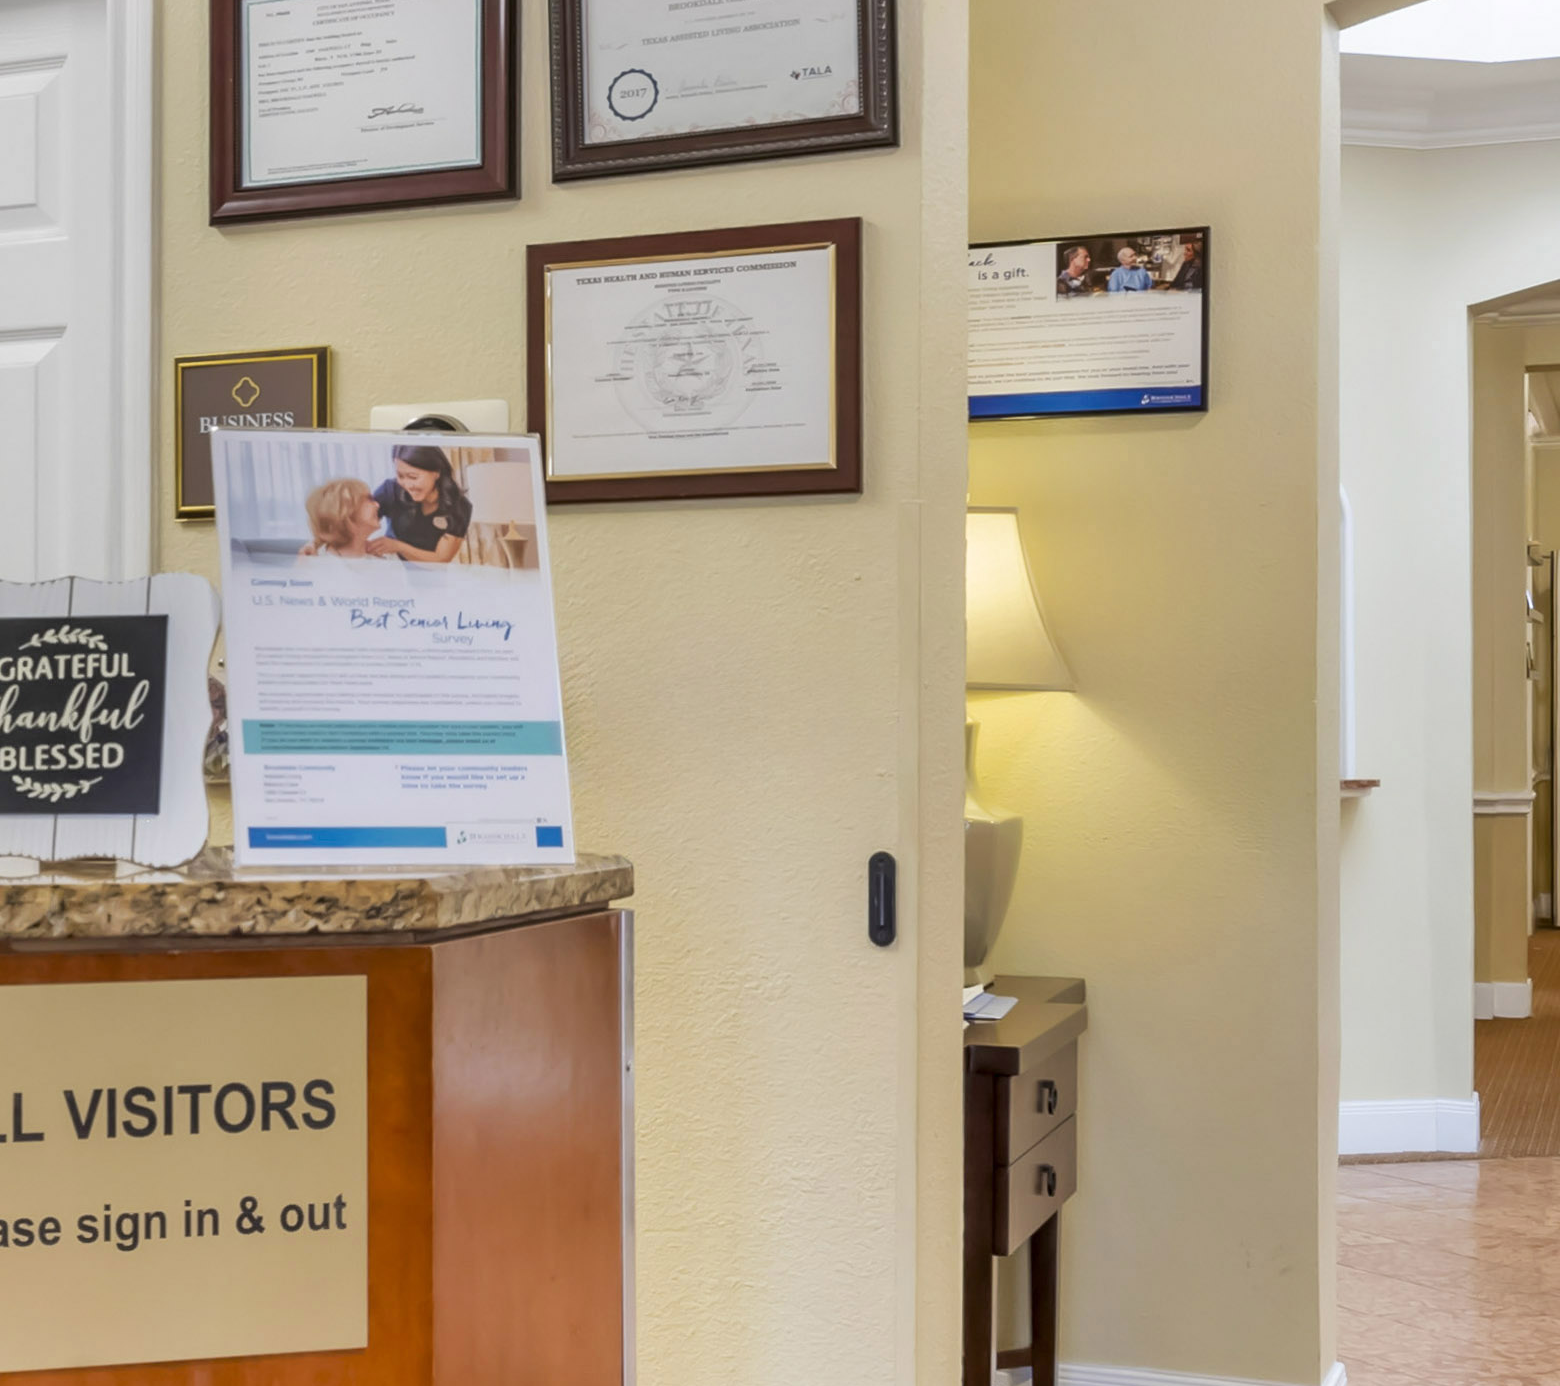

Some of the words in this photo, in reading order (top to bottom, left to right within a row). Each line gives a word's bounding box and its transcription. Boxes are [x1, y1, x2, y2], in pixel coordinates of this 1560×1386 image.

[802, 66, 832, 77] TALA
[620, 88, 648, 99] 2017
[576, 277, 602, 286] TEXAS
[604, 274, 637, 283] HEALTH
[639, 273, 657, 281] AND
[659, 269, 691, 279] HUMAN
[693, 266, 734, 277] SERVICES
[736, 261, 796, 273] COMMISSION
[978, 270, 987, 280] is
[992, 272, 999, 280] a
[1003, 268, 1030, 281] gift.
[330, 596, 369, 607] World
[373, 597, 415, 610] Report
[350, 608, 390, 629] Best
[398, 609, 448, 629] Senior
[457, 611, 514, 641] Living
[432, 632, 474, 646] Survey
[63, 1078, 337, 1140] VISITORS
[76, 1204, 167, 1251] sign
[184, 1199, 220, 1238] in
[235, 1195, 266, 1235] &
[280, 1193, 347, 1233] out
